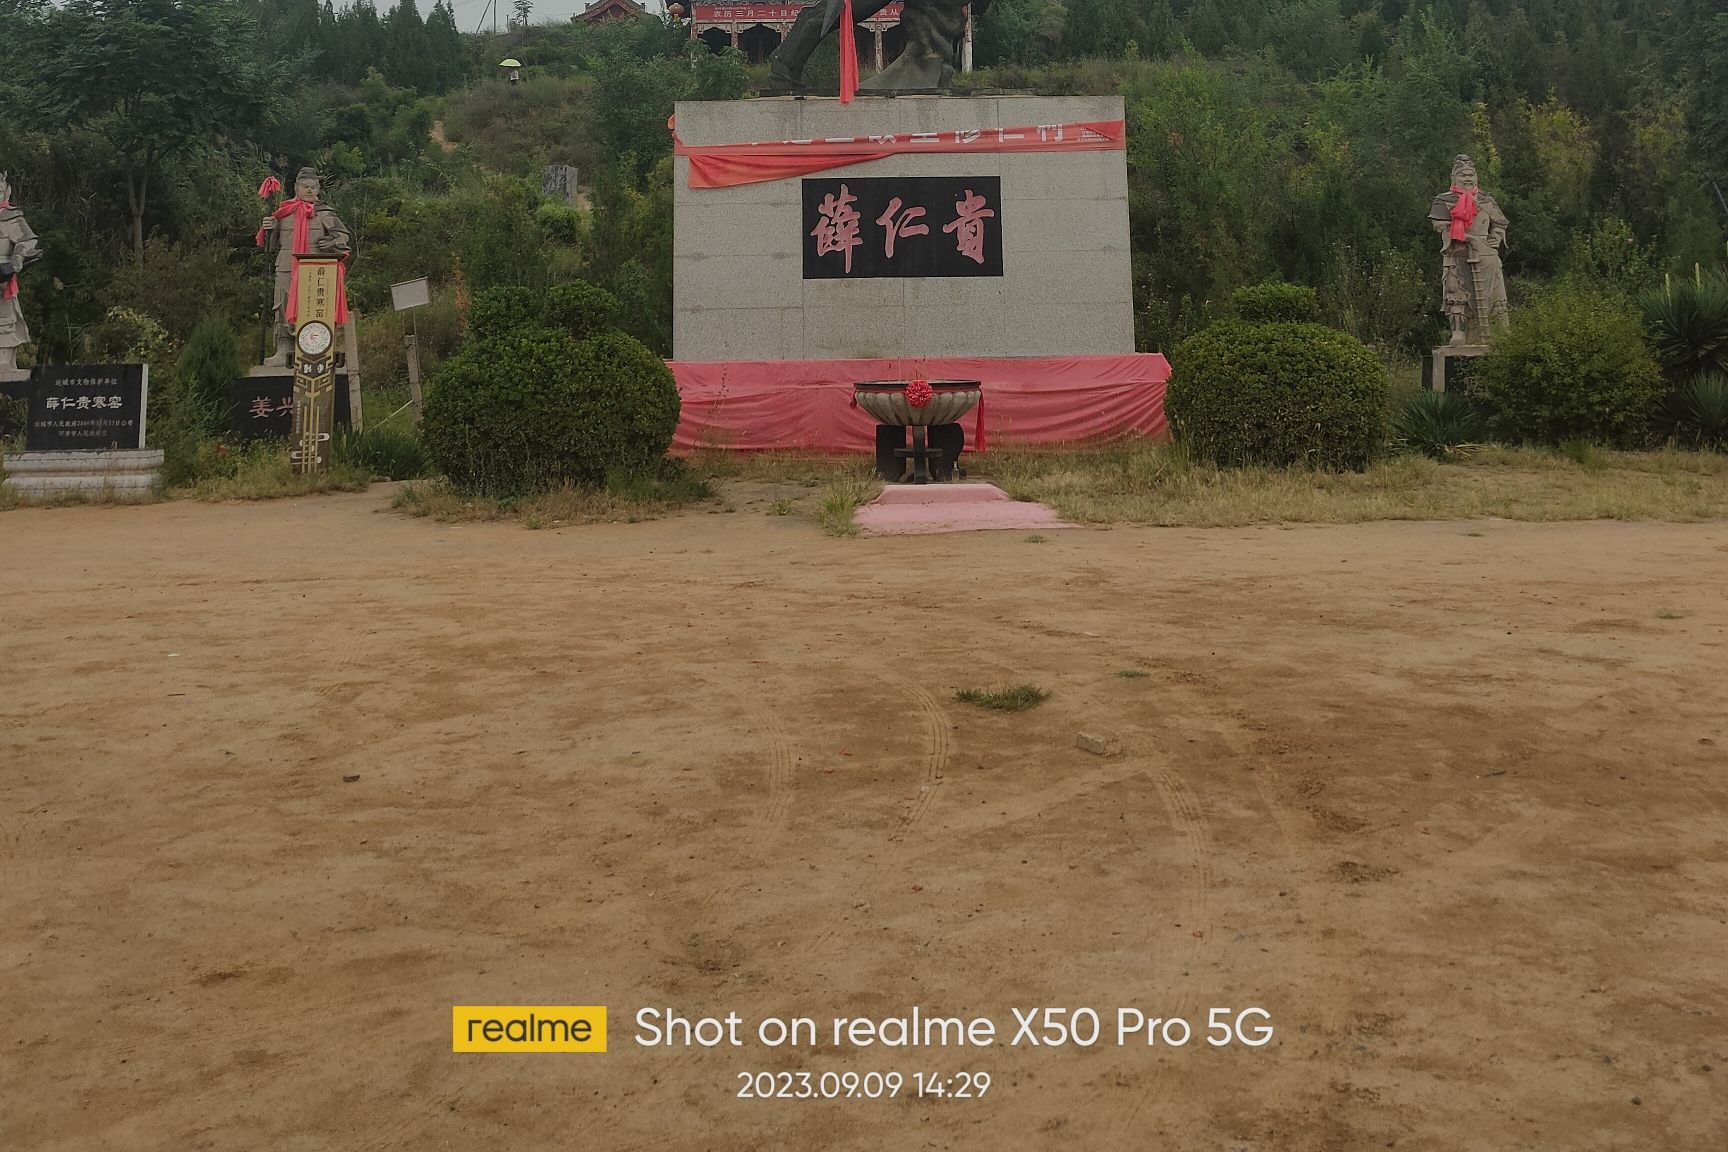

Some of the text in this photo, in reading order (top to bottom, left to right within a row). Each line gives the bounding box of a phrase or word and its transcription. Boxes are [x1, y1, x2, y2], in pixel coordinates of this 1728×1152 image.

[46, 395, 122, 410] 薛仁贵寒窑
